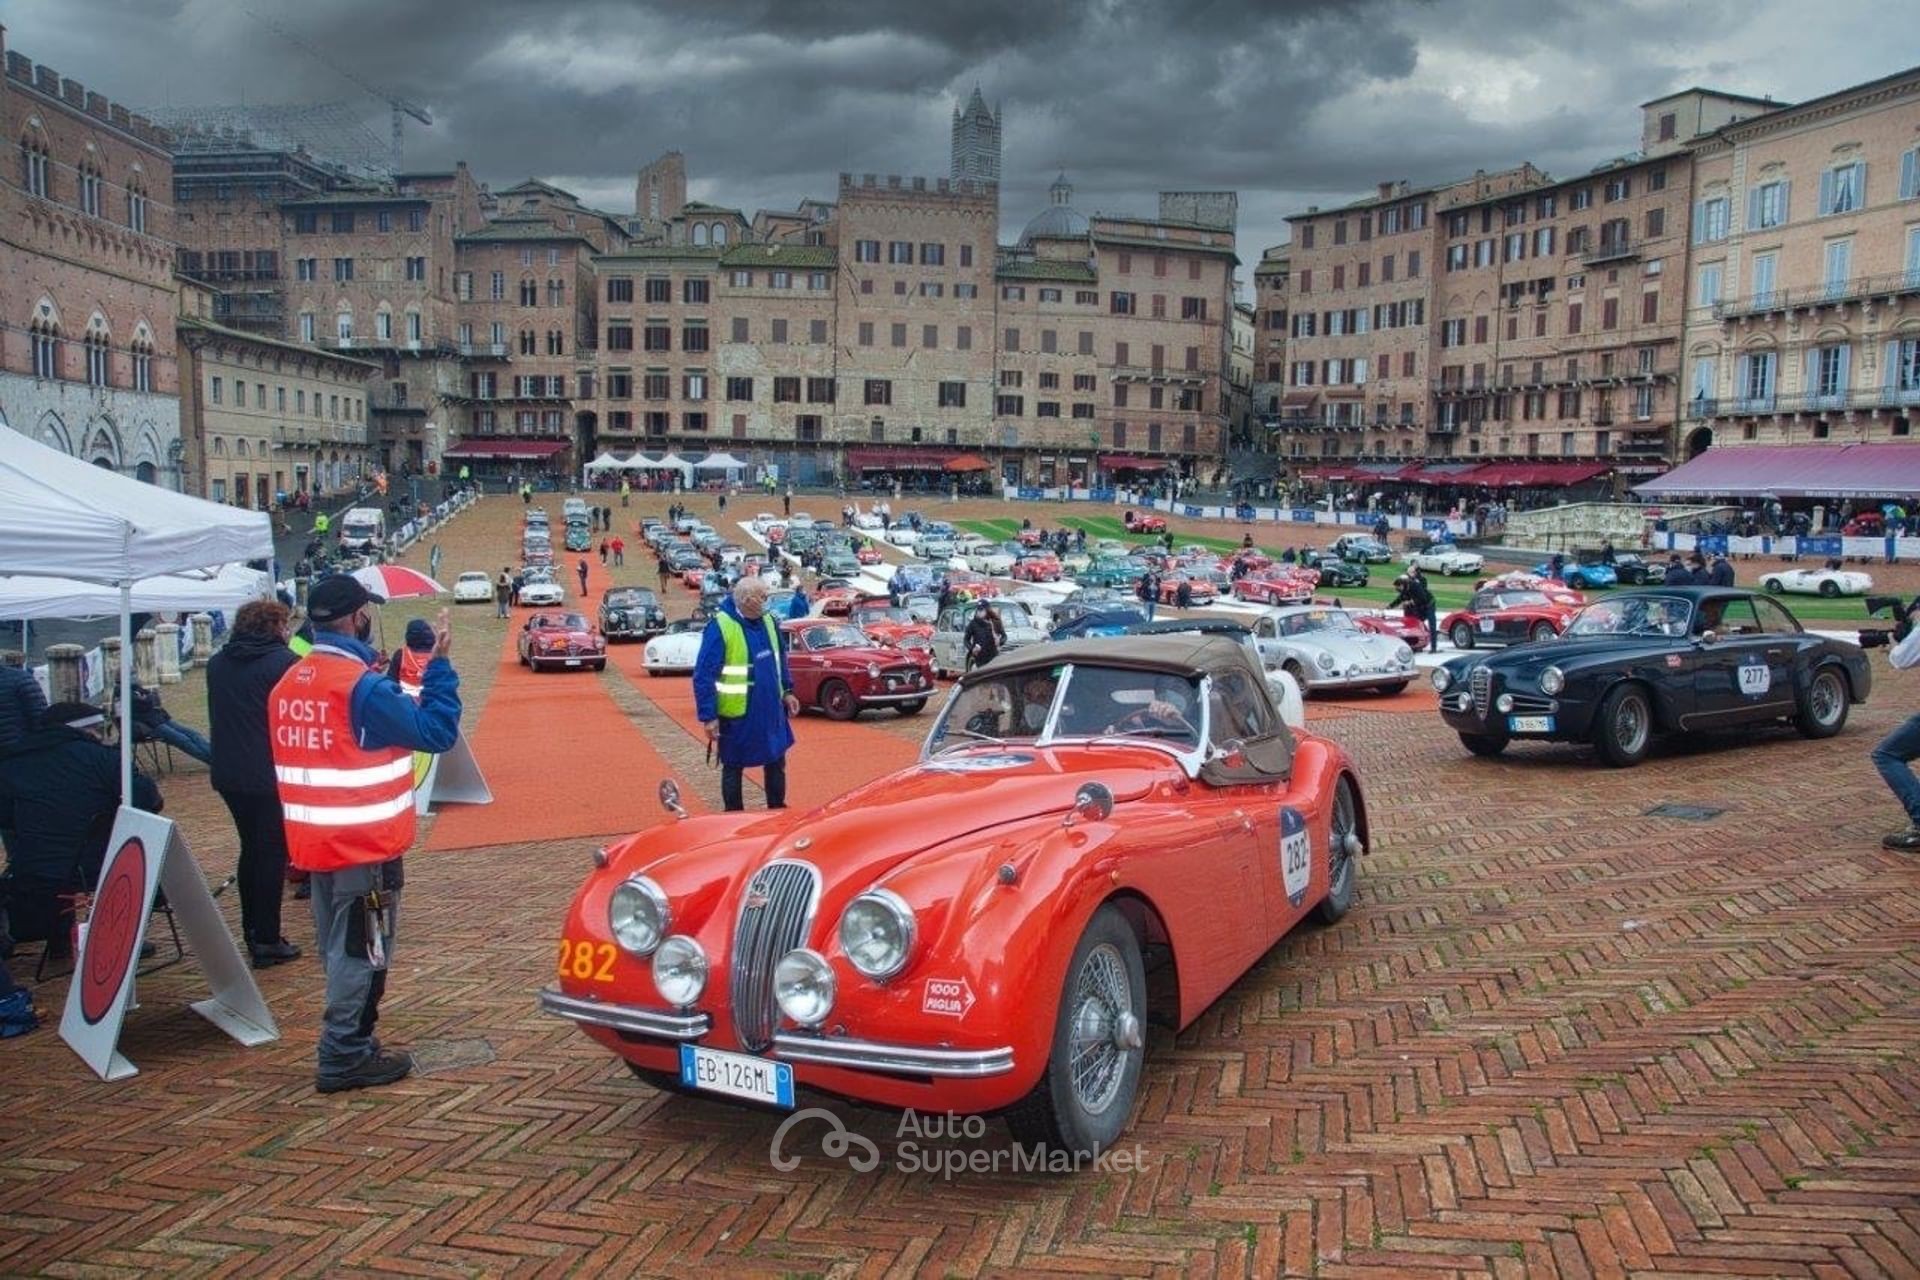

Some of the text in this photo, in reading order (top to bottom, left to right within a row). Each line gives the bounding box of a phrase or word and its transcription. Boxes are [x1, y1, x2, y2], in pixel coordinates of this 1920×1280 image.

[1744, 668, 1764, 684] 277
[278, 698, 329, 724] POST
[276, 725, 334, 751] CHIEF
[1287, 837, 1307, 875] 282
[559, 938, 618, 983] 282
[930, 984, 960, 996] 1000
[926, 997, 962, 1012] MIGLIA
